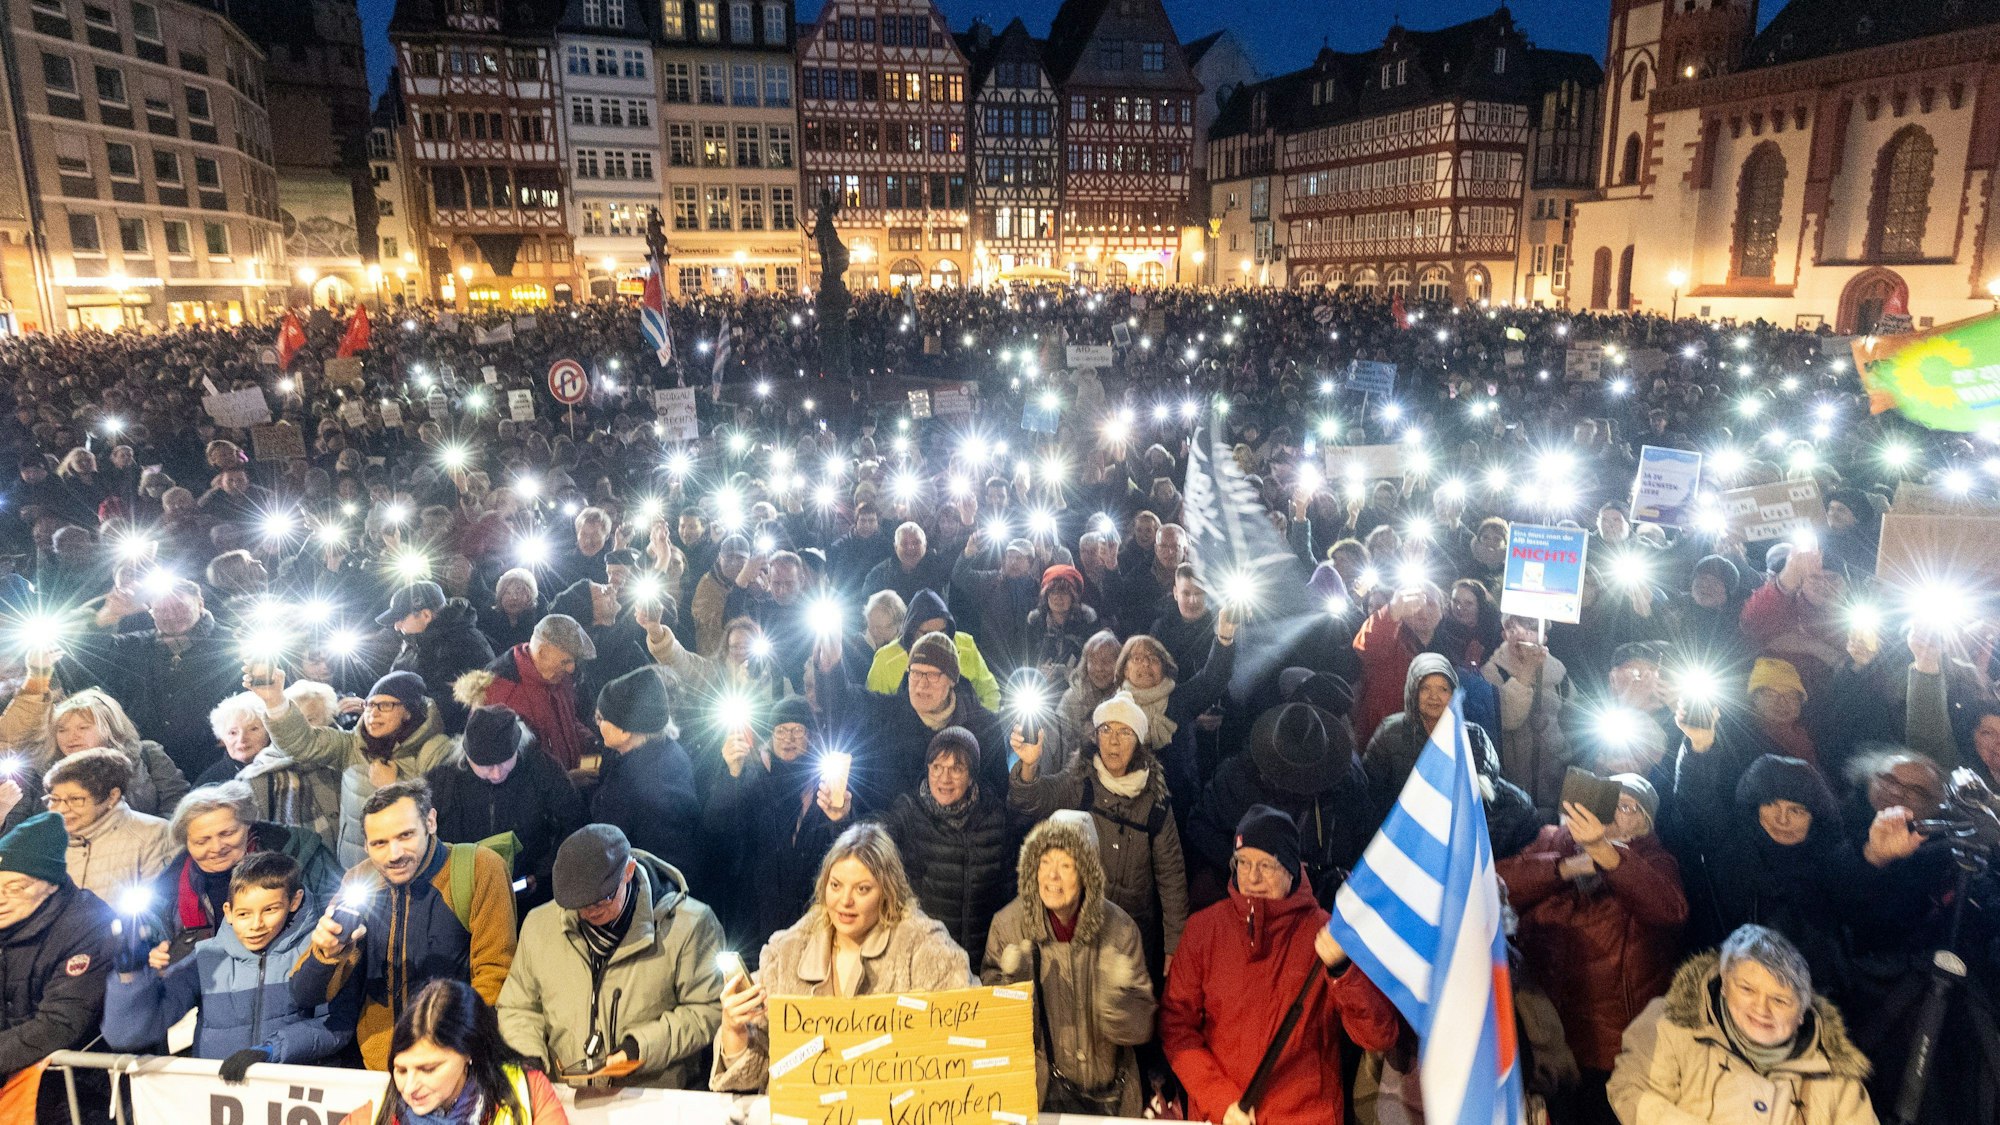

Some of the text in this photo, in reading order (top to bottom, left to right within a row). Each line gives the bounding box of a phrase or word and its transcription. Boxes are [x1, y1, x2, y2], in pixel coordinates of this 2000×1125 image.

[1511, 546, 1578, 565] NICHTS
[929, 1000, 981, 1031] heißt
[811, 1046, 966, 1086] Gemeinsam
